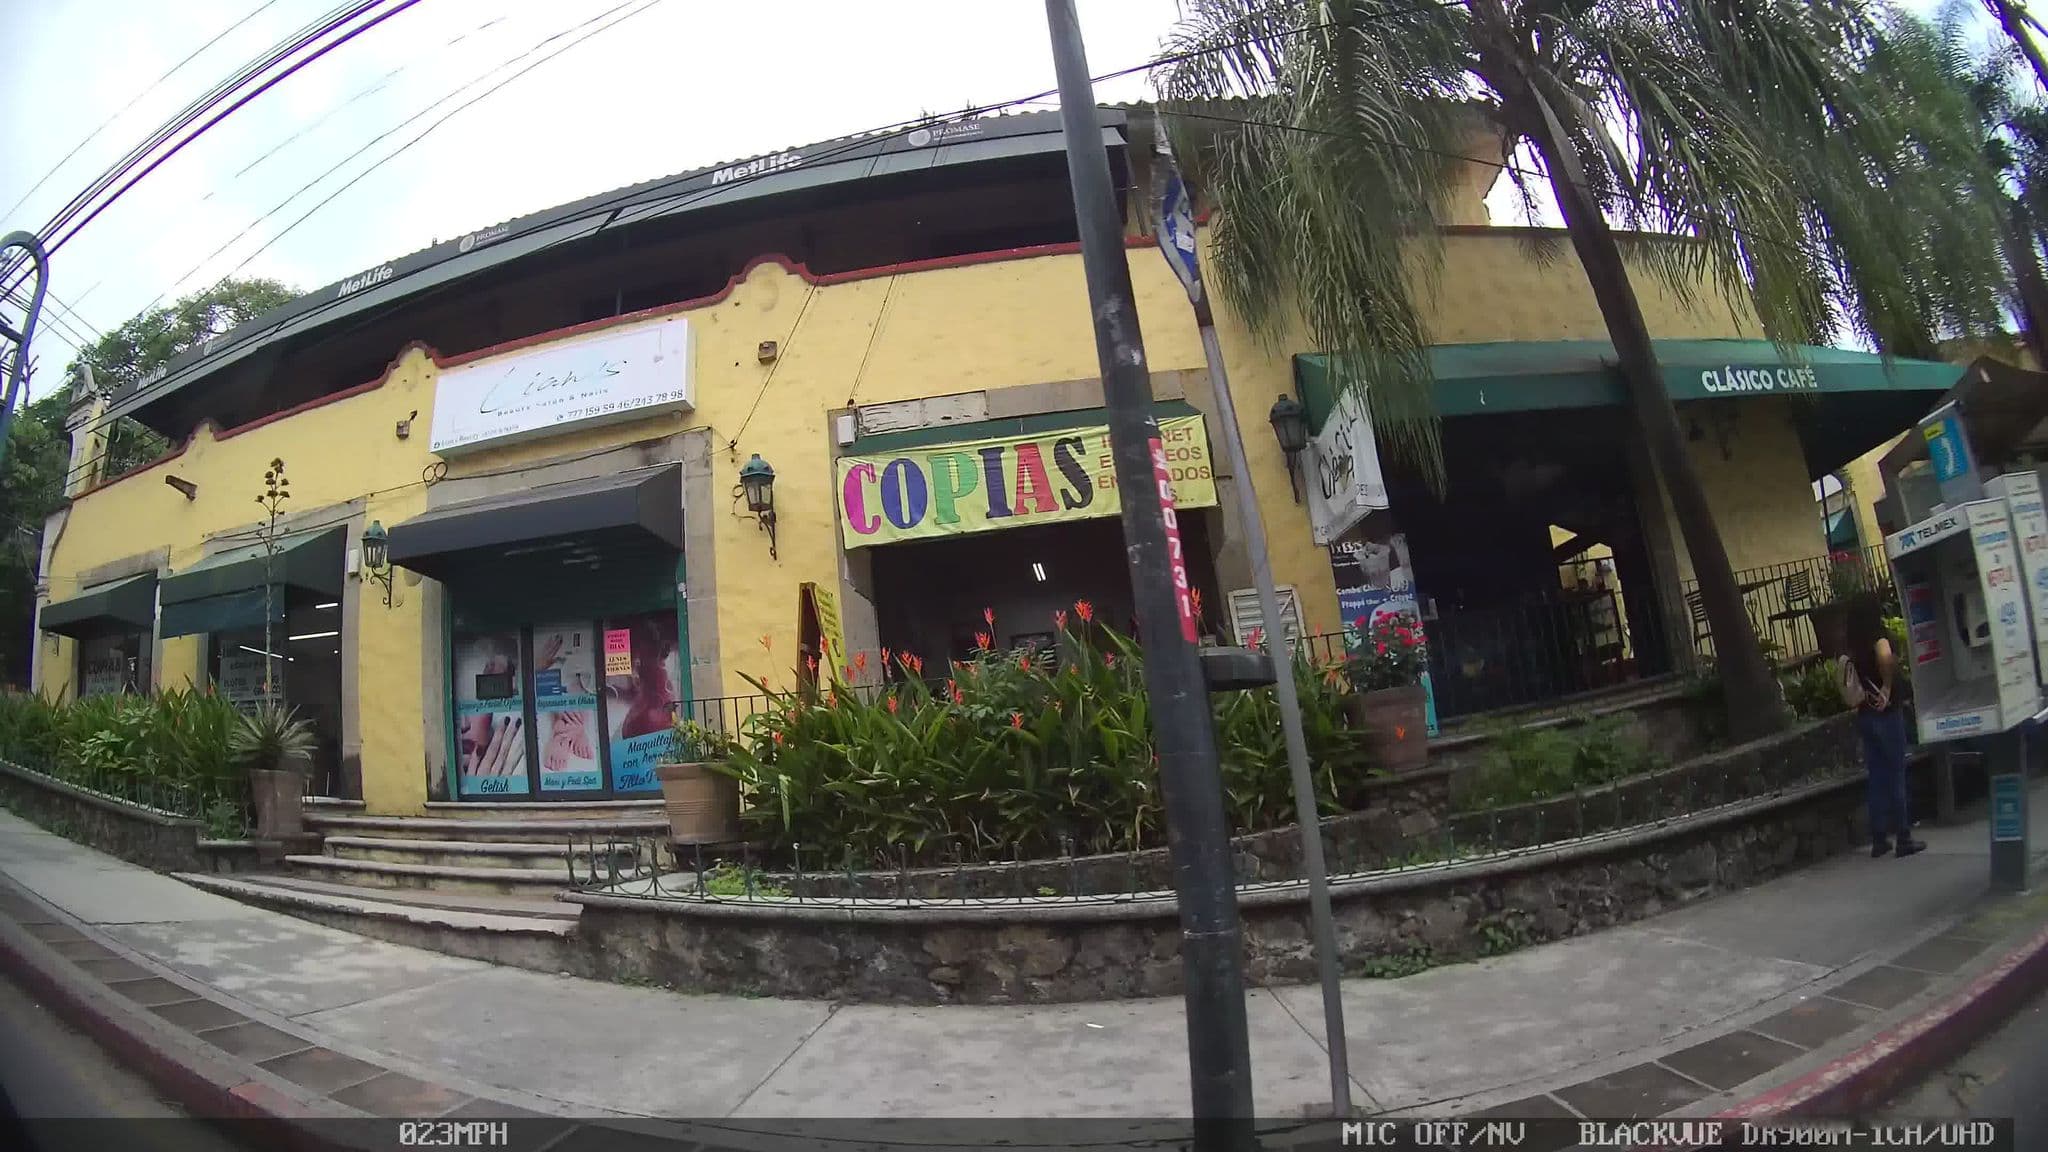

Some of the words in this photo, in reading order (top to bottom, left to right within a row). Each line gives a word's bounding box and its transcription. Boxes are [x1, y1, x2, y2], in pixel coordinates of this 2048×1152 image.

[711, 152, 802, 186] MetLife
[337, 264, 393, 298] MetLife
[1701, 365, 1774, 393] CLÁSICO
[1776, 364, 1818, 389] CAFÉ
[585, 406, 601, 416] 159
[603, 403, 615, 412] 59
[656, 392, 668, 402] 78
[671, 389, 684, 400] 98
[843, 436, 1094, 535] COPIAS
[1917, 517, 1958, 540] TELMEX
[480, 779, 510, 793] Gelish
